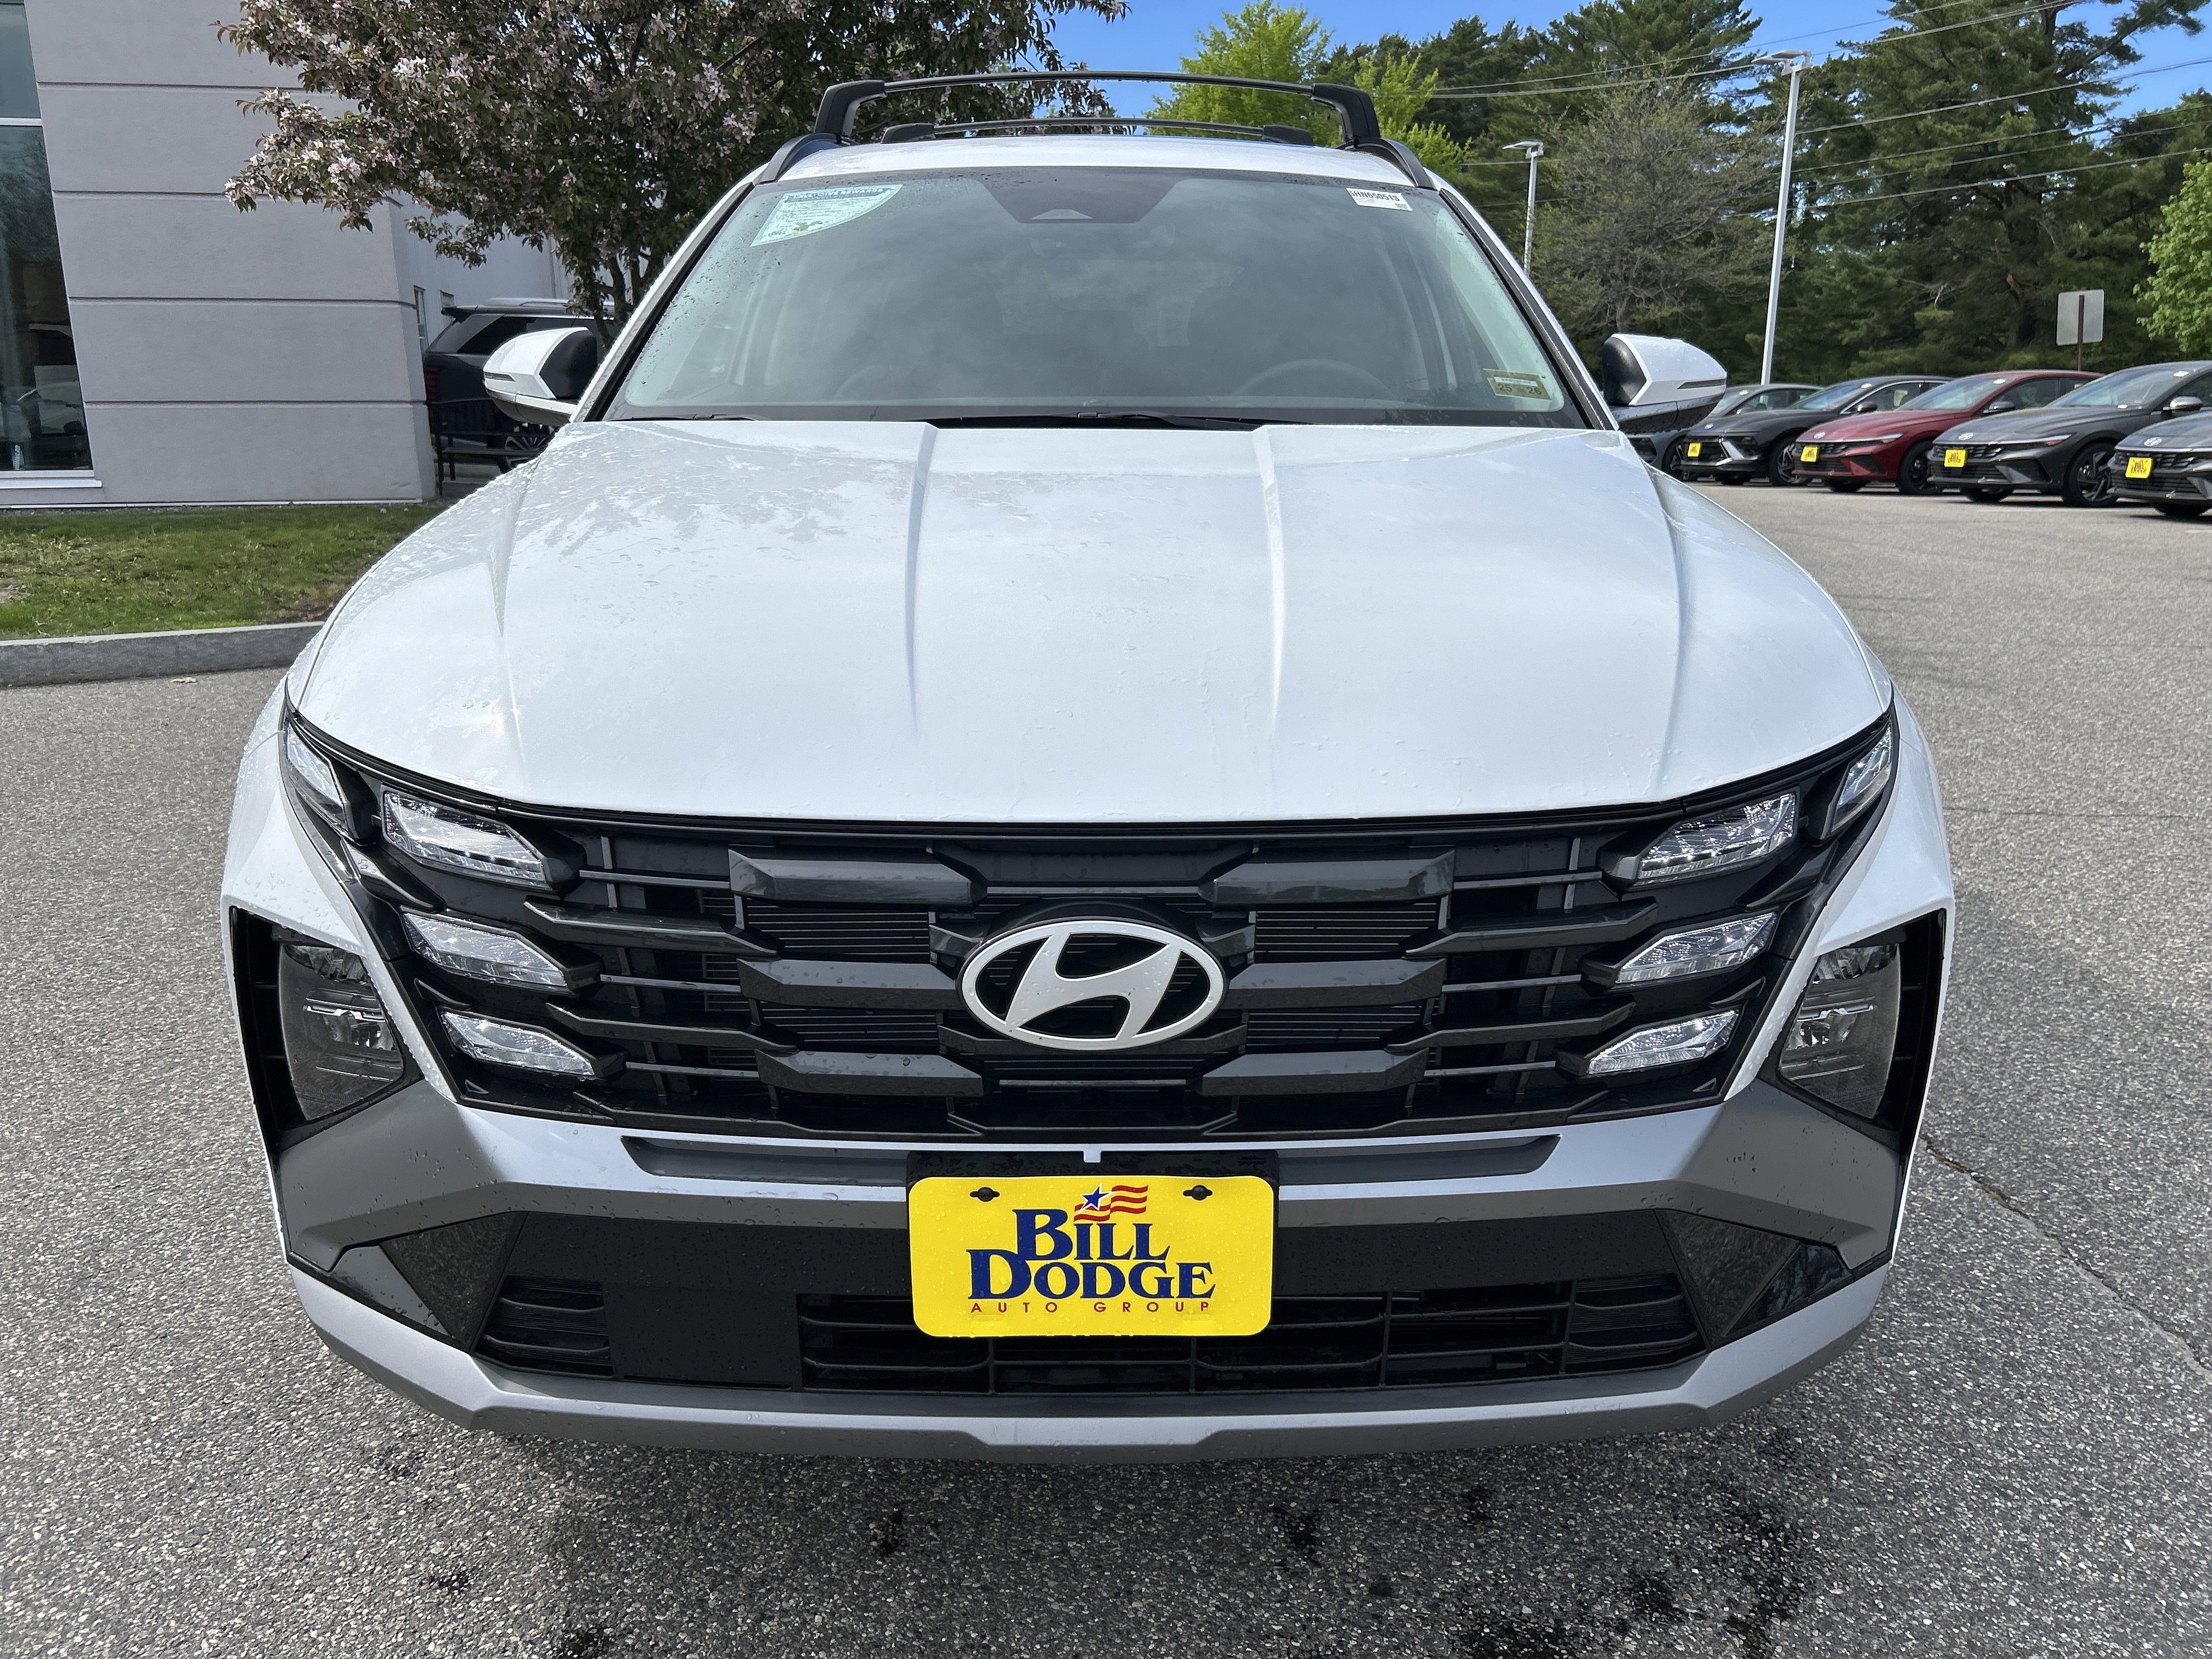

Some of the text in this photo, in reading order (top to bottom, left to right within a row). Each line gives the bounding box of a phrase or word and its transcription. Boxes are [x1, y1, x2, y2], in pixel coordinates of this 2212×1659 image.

[1498, 384, 1512, 392] 25
[1527, 387, 1542, 395] 26
[1012, 1209, 1171, 1261] BILL
[966, 1249, 1216, 1300] DODGE
[970, 1301, 1209, 1313] AUTO GROUP
